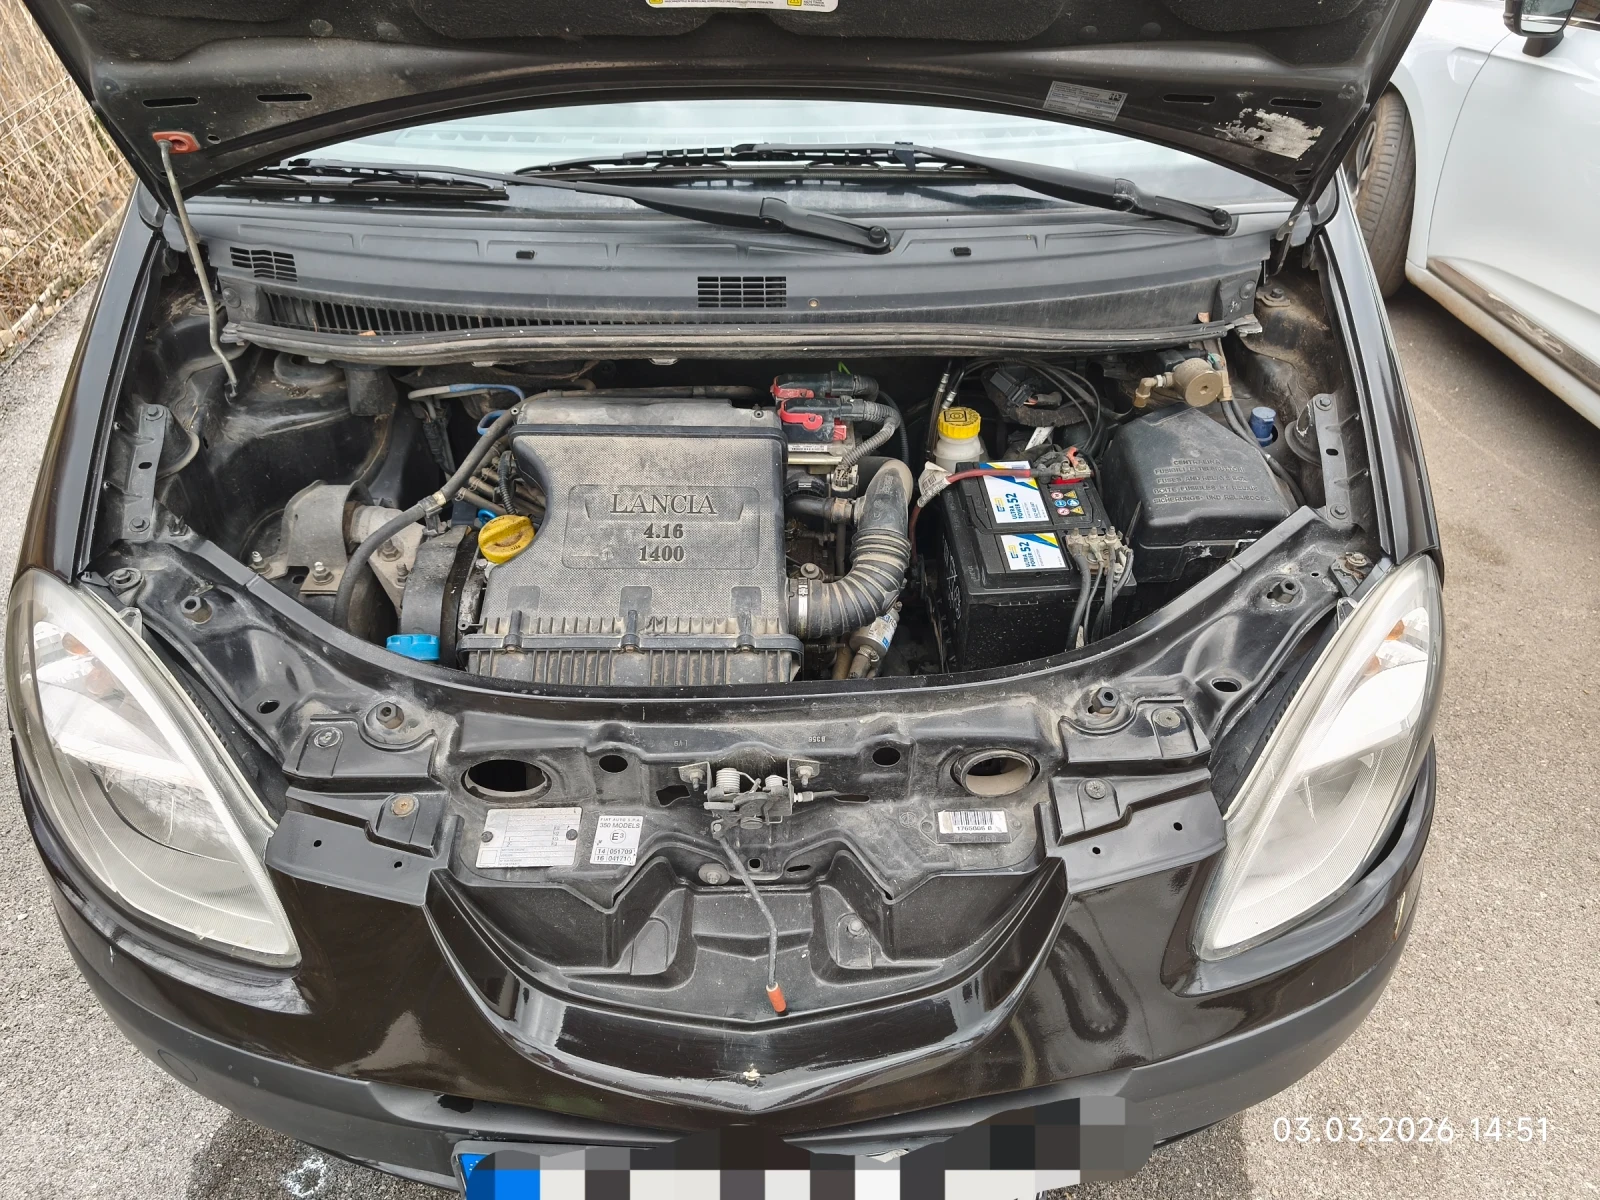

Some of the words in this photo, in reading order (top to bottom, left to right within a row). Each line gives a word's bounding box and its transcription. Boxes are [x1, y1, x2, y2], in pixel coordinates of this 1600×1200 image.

[610, 493, 717, 515] LANCIA
[1005, 493, 1018, 503] 52
[1009, 505, 1018, 520] ULTRA
[1015, 503, 1024, 519] POWER
[643, 523, 684, 539] 4.16
[639, 545, 685, 561] 1400
[1018, 541, 1031, 552] 52
[1022, 554, 1031, 567] ULTRA
[1028, 552, 1036, 567] POWER
